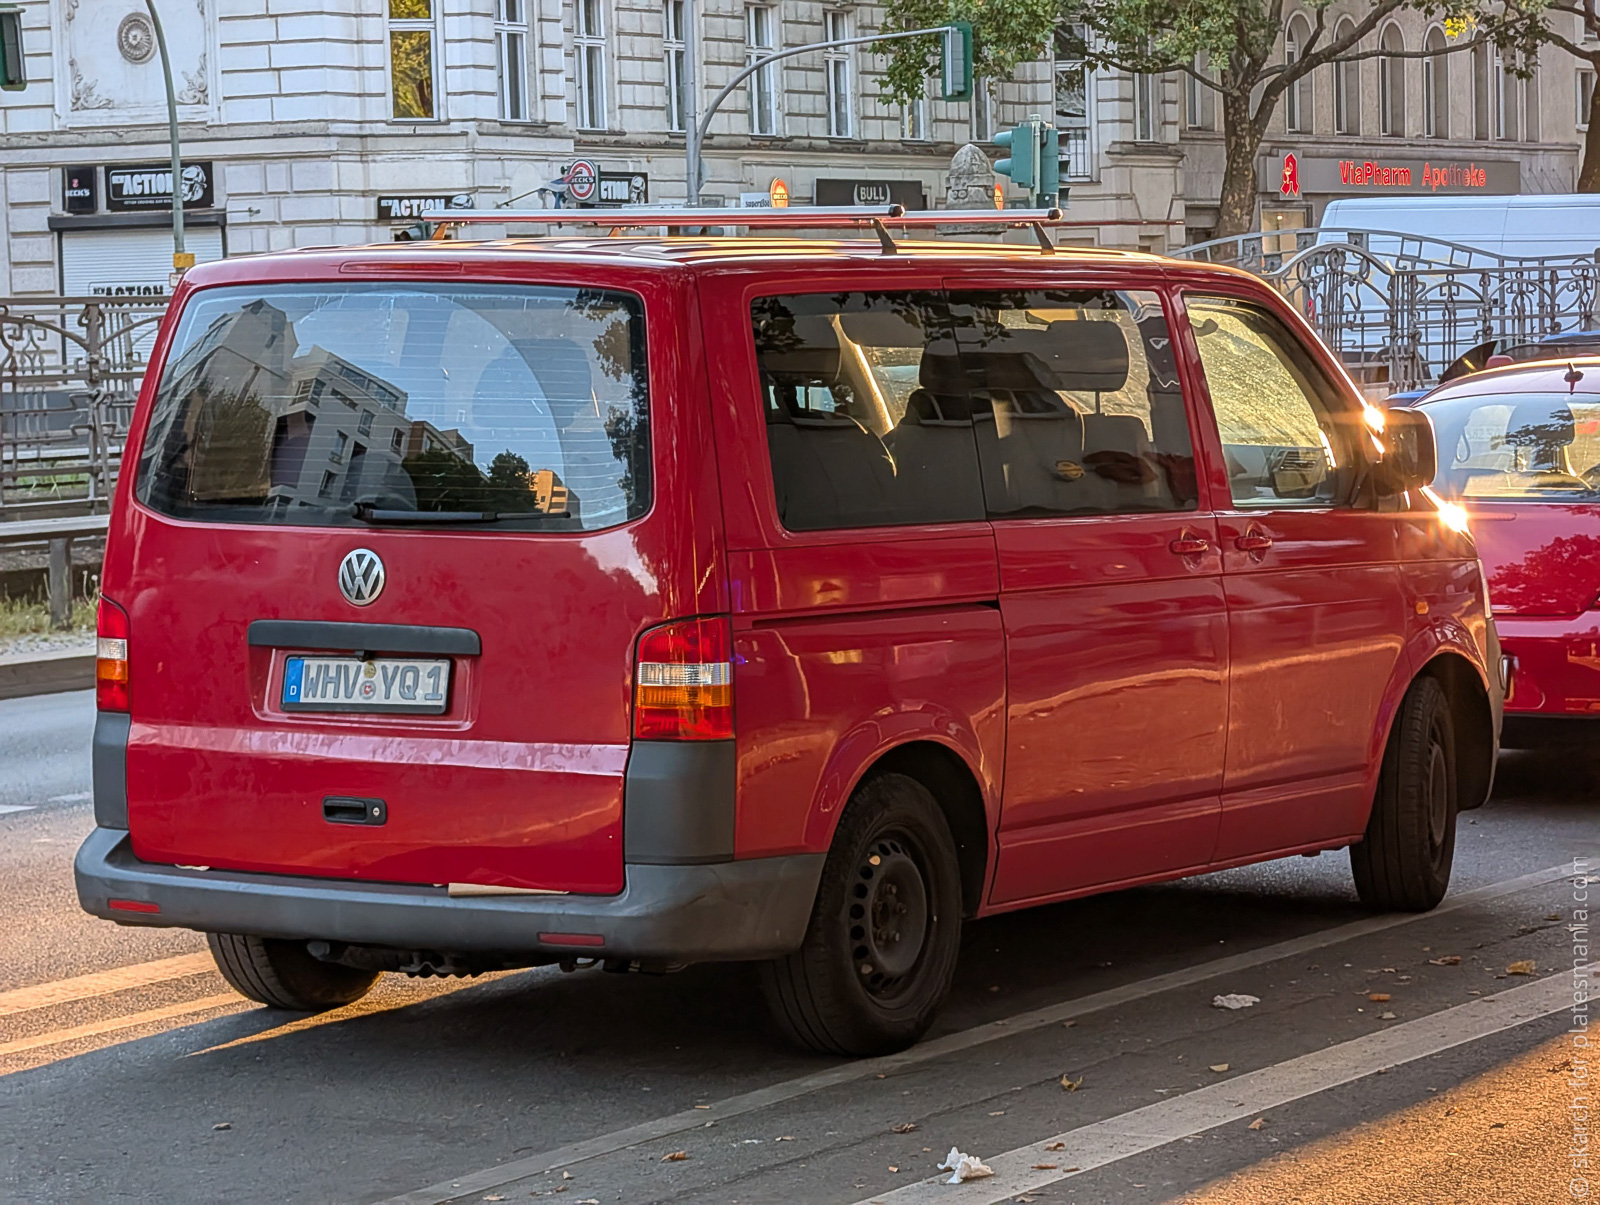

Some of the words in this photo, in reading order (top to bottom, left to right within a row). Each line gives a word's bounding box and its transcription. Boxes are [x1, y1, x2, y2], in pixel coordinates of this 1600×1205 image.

[122, 173, 173, 196] ACTION
[1338, 160, 1411, 186] ViaPharm
[1422, 162, 1486, 191] Apotheke
[600, 180, 629, 200] CTION
[860, 186, 885, 200] BULL
[390, 198, 445, 217] ACTION
[289, 685, 297, 696] D
[303, 664, 362, 699] WHV
[381, 665, 420, 700] YQ
[424, 665, 443, 700] 1
